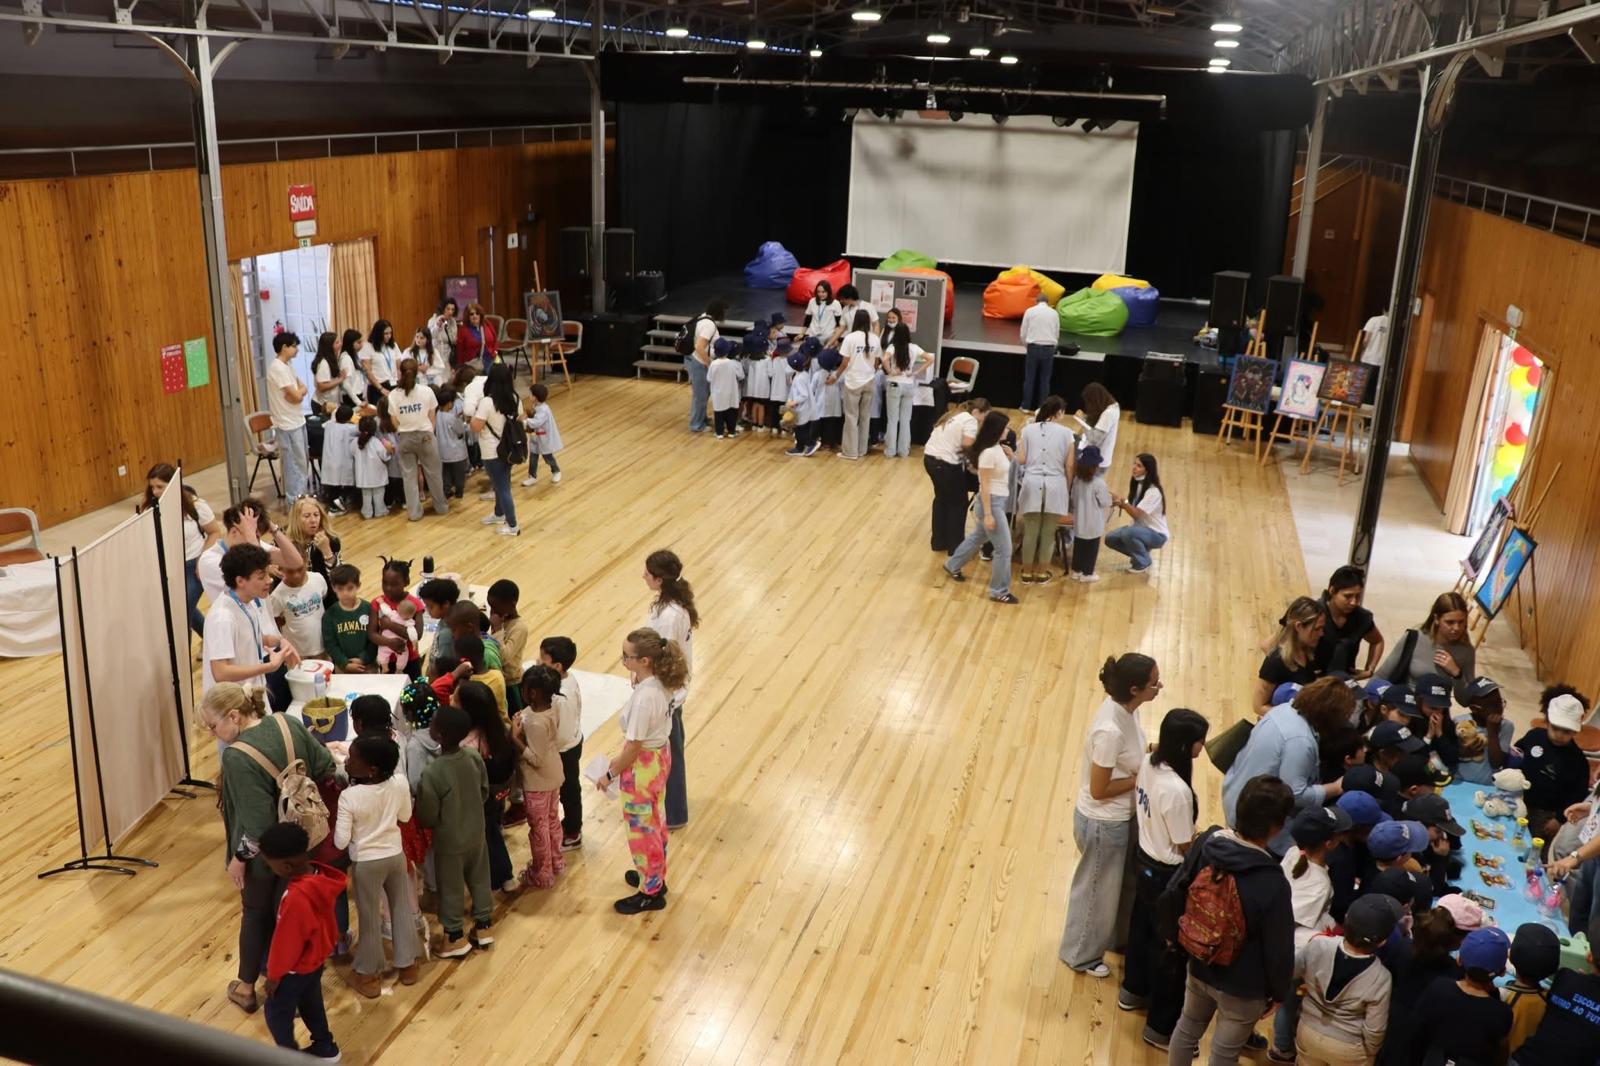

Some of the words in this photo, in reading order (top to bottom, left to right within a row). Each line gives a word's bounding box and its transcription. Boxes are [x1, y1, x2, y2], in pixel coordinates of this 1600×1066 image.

[290, 192, 314, 213] SAÍDA
[399, 403, 421, 414] STAFF
[1572, 1006, 1584, 1015] AO
